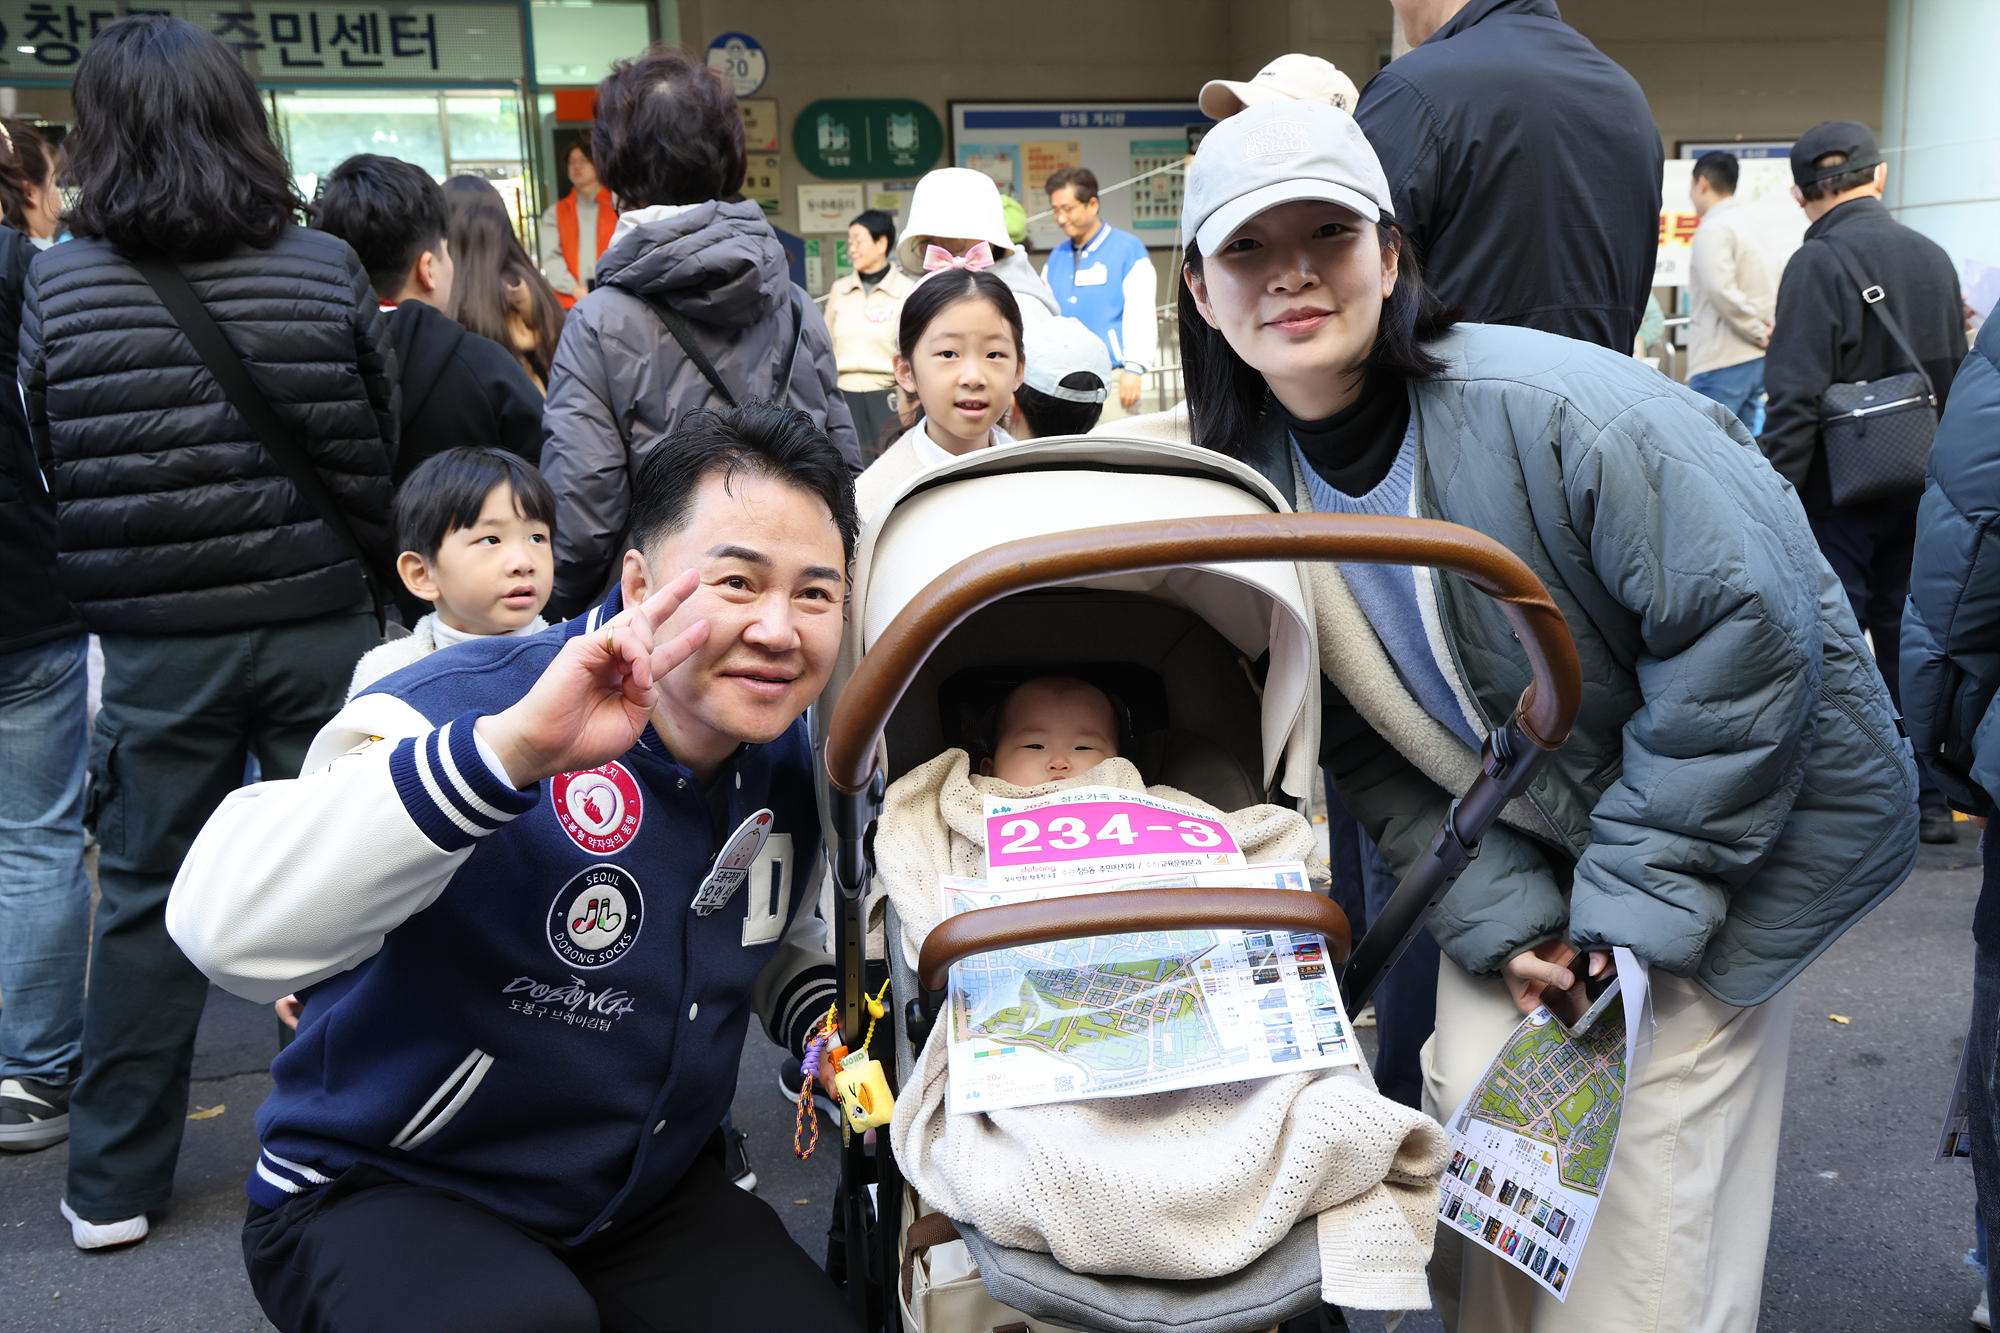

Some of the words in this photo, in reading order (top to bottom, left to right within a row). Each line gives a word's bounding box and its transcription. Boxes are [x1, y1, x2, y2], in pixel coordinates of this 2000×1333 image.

[1245, 140, 1310, 157] GIRBAUD
[1266, 154, 1290, 162] PARIS
[1023, 801, 1054, 811] 2025.
[1060, 793, 1110, 803] 창오가족
[560, 813, 586, 842] 도봉형
[587, 832, 624, 851] 약자와의
[620, 814, 637, 835] 동행
[1000, 813, 1222, 854] 234-3
[586, 872, 620, 886] SEOUL
[1021, 865, 1056, 873] dobong
[742, 833, 794, 947] D
[554, 932, 595, 964] DOBONG
[598, 933, 632, 963] SOCKS
[508, 999, 549, 1018] 도봉구
[550, 1009, 612, 1032] 브레이킹팀
